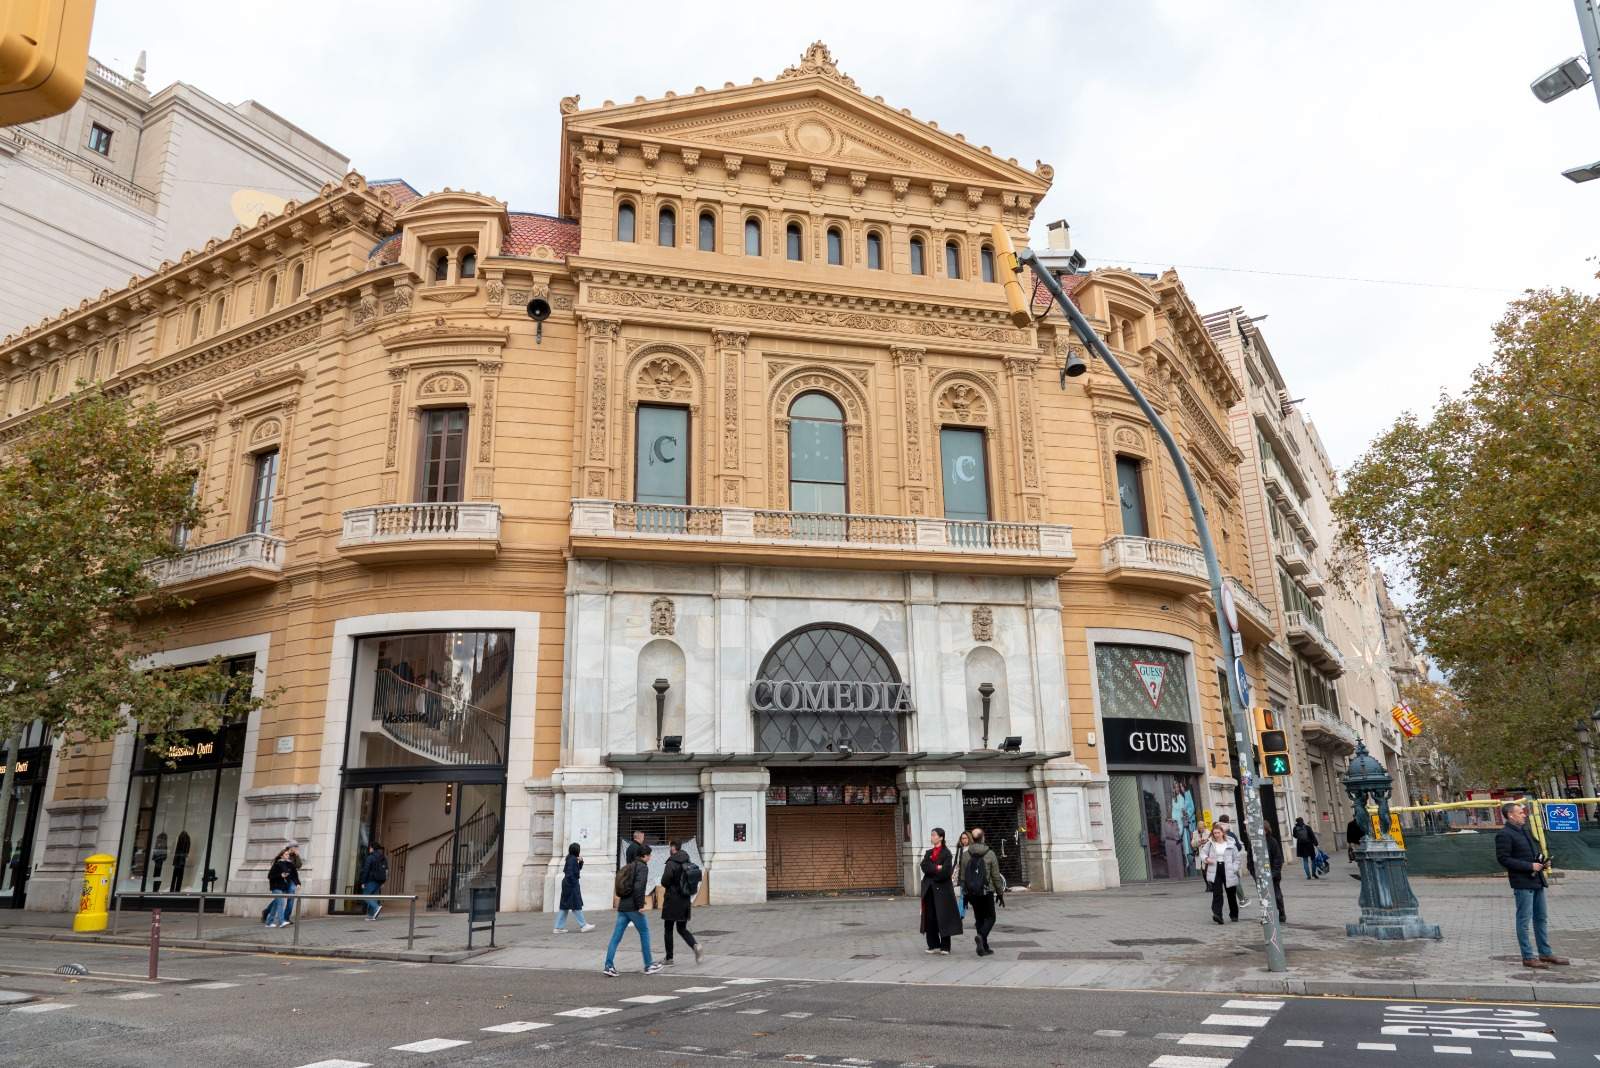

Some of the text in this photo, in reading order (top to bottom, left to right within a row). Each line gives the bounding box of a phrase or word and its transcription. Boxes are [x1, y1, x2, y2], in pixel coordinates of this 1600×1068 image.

[1139, 666, 1162, 677] GUESS
[750, 679, 917, 713] COMEDIA
[196, 741, 214, 755] Dutti
[1129, 731, 1187, 753] GUESS
[624, 798, 650, 810] cine
[963, 793, 1014, 807] ine yelmo
[1380, 1005, 1559, 1043] BUS
